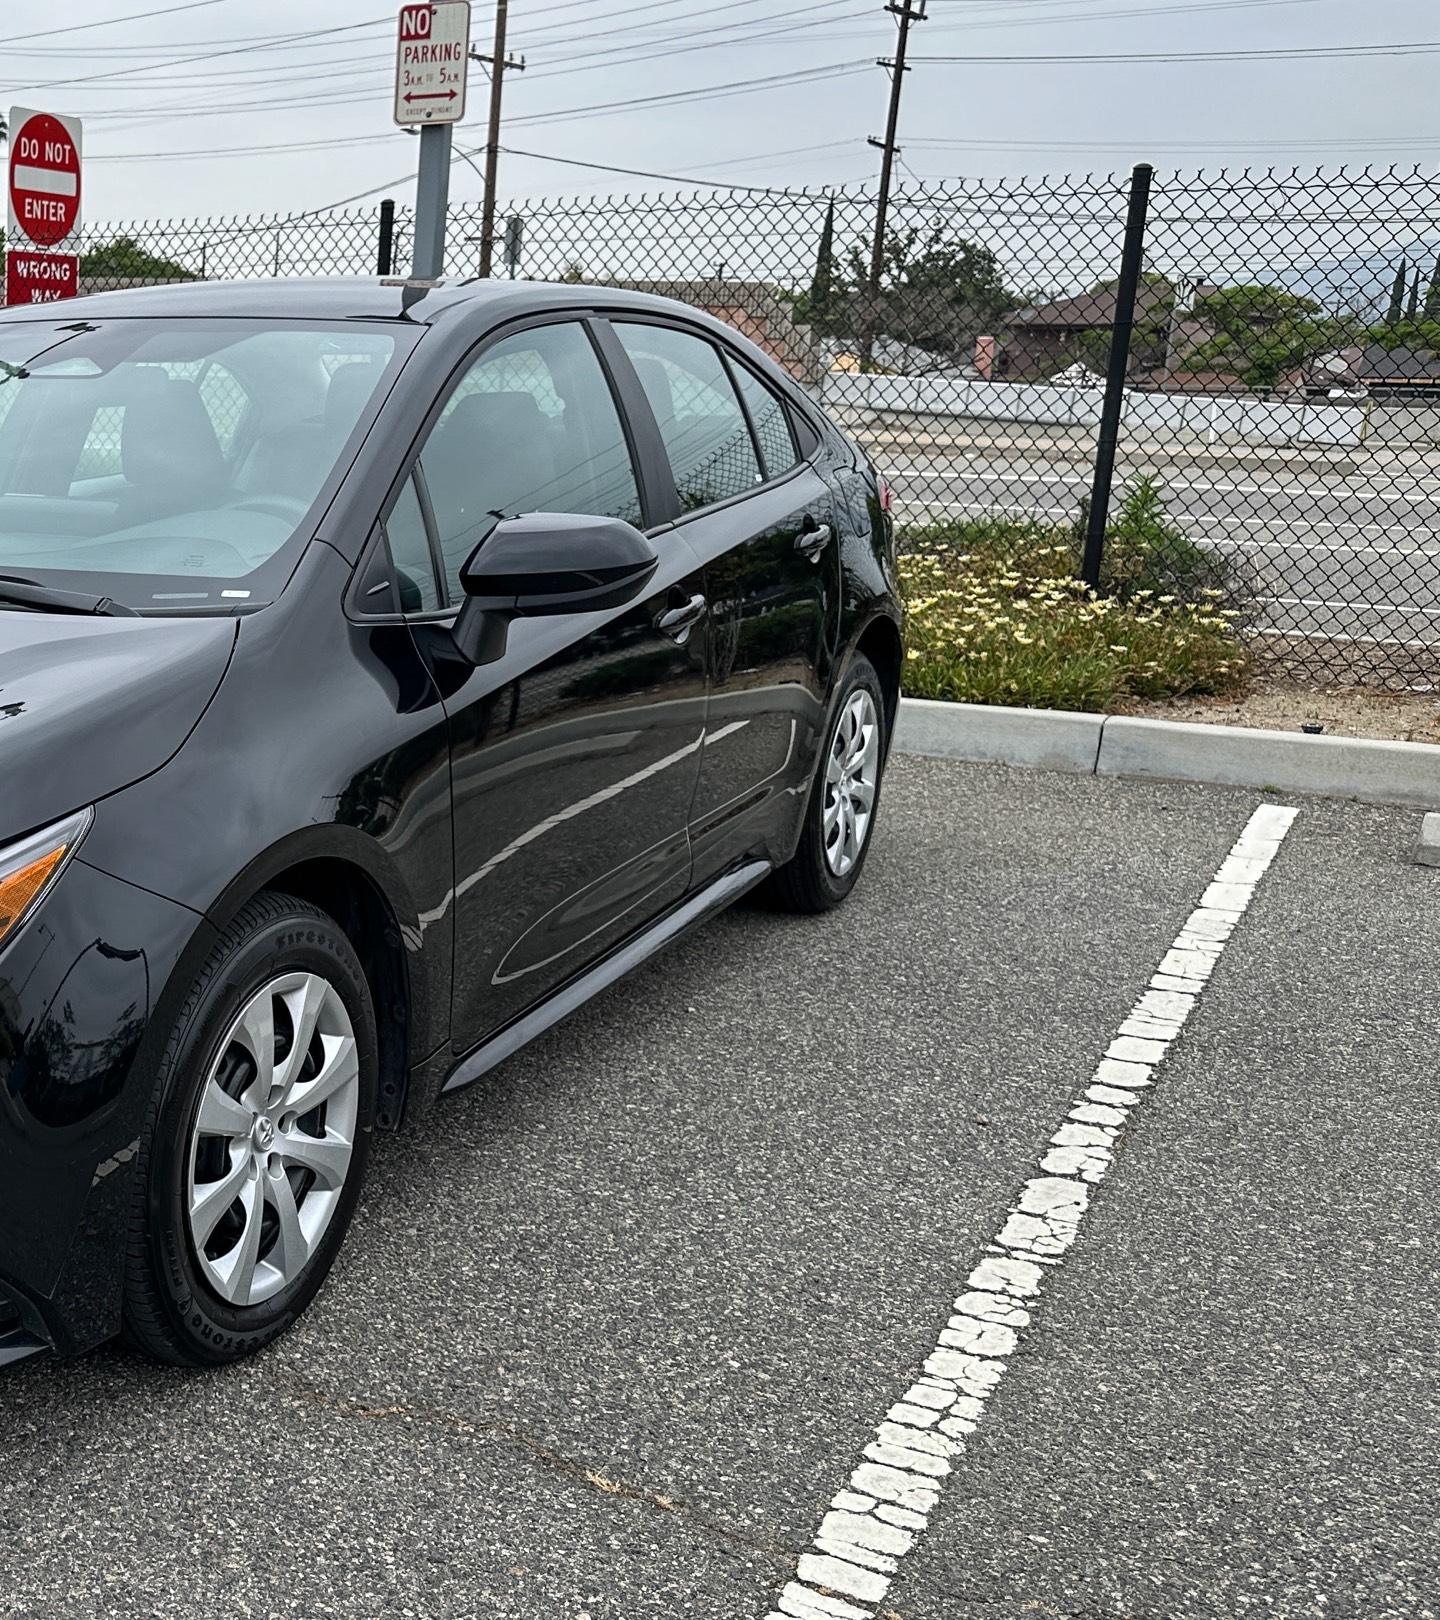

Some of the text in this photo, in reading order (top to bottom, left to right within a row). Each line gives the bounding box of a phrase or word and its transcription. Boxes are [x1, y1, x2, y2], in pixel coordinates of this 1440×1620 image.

[402, 9, 430, 37] NO
[404, 42, 461, 64] PARKING
[20, 137, 71, 165] DO NOT
[24, 198, 66, 222] ENTER
[16, 260, 70, 281] WRONG
[31, 288, 61, 303] WAY
